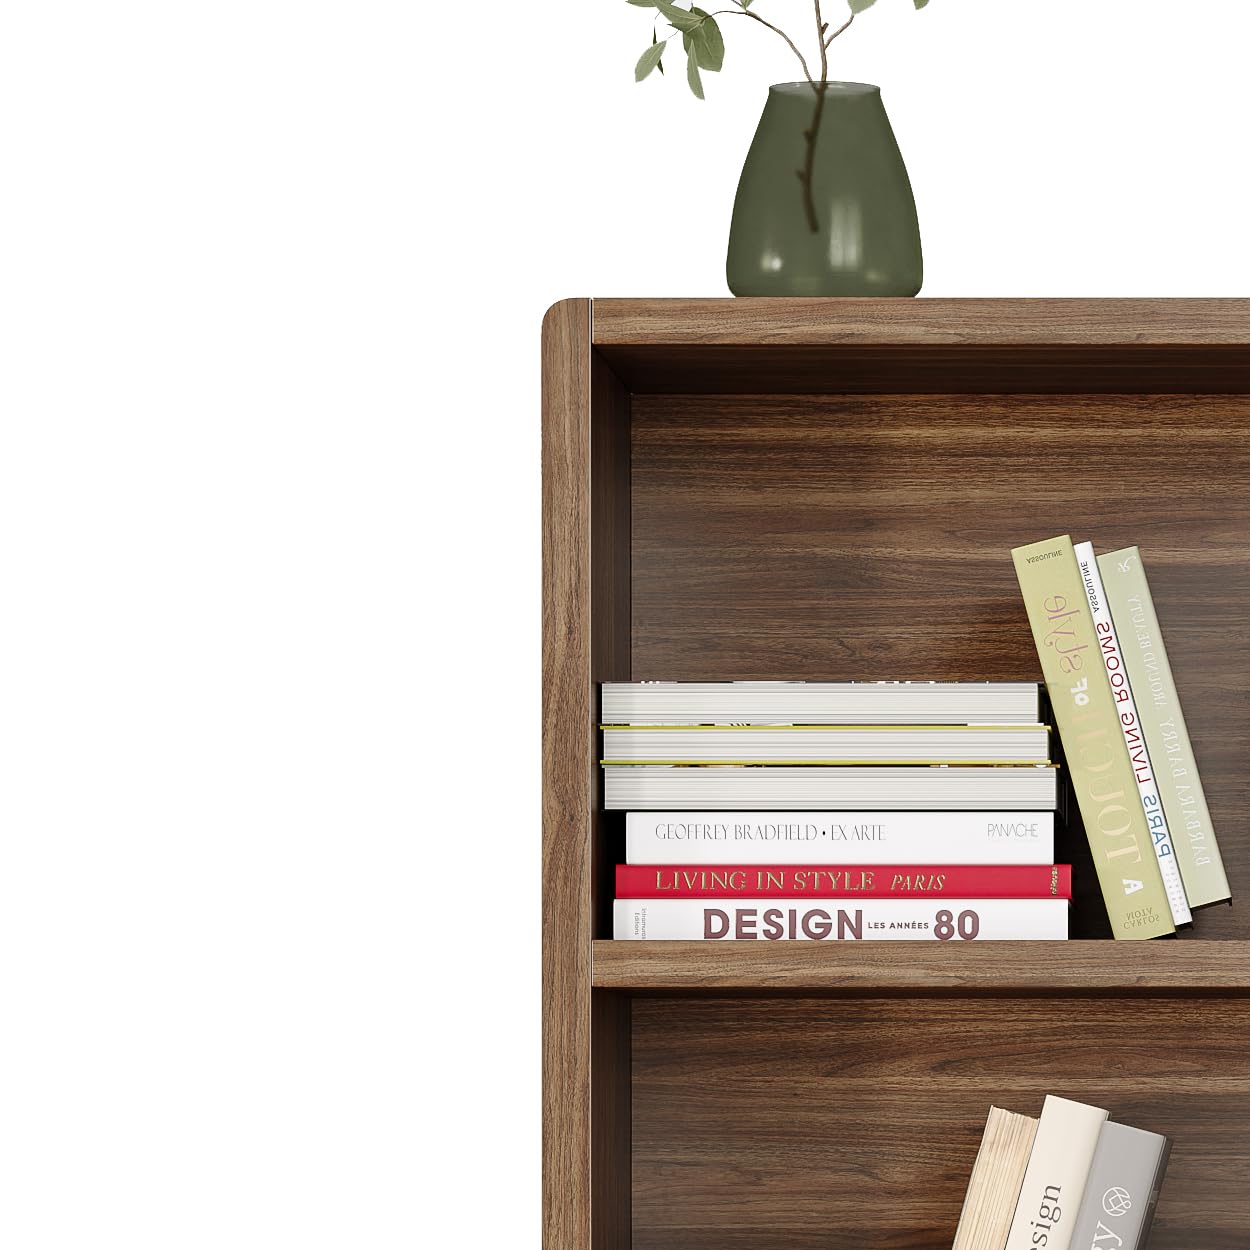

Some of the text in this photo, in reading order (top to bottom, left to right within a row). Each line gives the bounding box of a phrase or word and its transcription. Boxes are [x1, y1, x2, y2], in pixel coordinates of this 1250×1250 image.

[655, 823, 888, 841] GEOFFREY BRADFIELD EX ARTE
[987, 823, 1039, 838] PANACHE
[655, 871, 946, 891] LIVING IN STYLE PARIS
[703, 908, 863, 940] DESIGN
[889, 919, 930, 930] ANNÉES
[933, 909, 980, 941] 80
